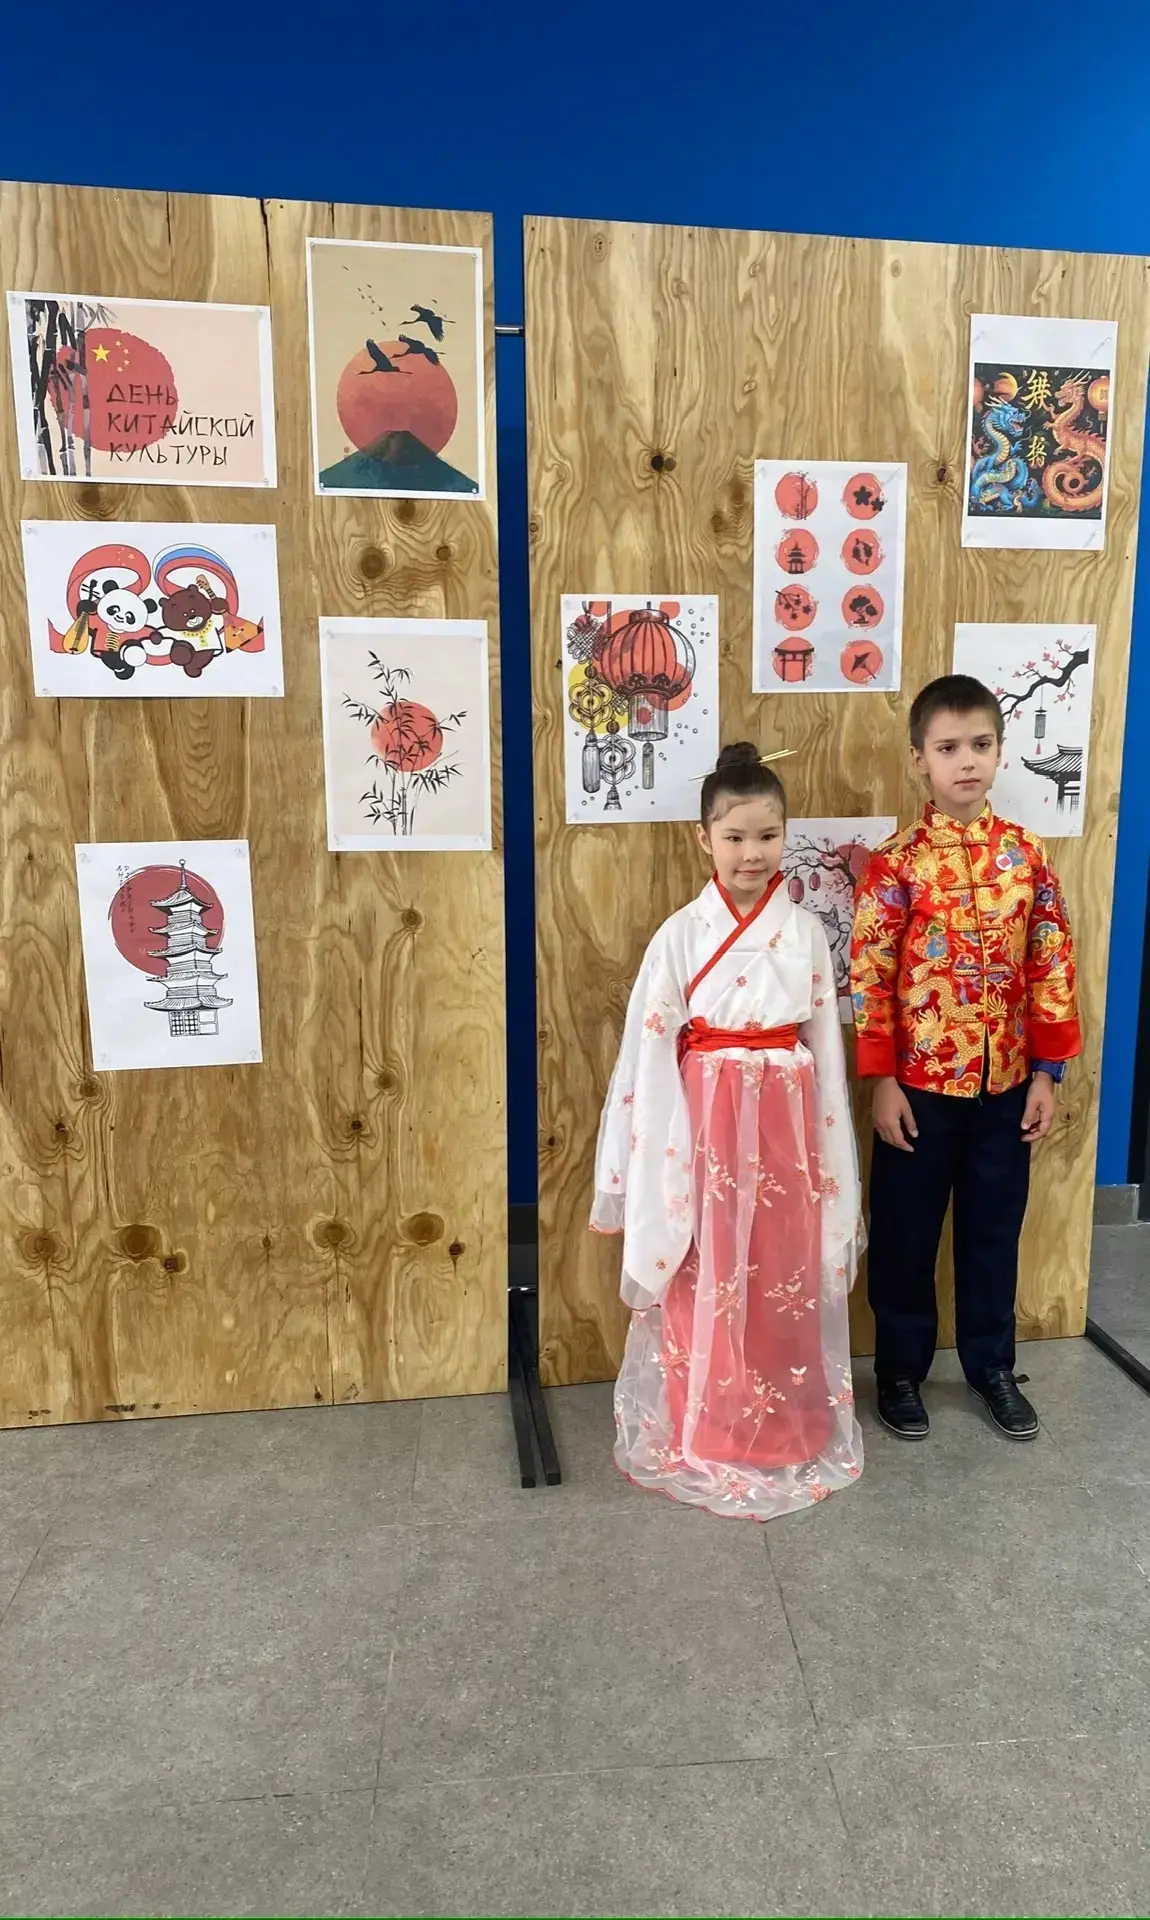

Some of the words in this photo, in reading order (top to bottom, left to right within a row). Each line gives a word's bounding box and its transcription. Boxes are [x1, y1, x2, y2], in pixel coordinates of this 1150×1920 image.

[106, 383, 178, 405] ДЕНЬ
[107, 410, 255, 438] КИТАЙСКОЙ
[109, 442, 227, 466] КУЛЬТУРЫ
